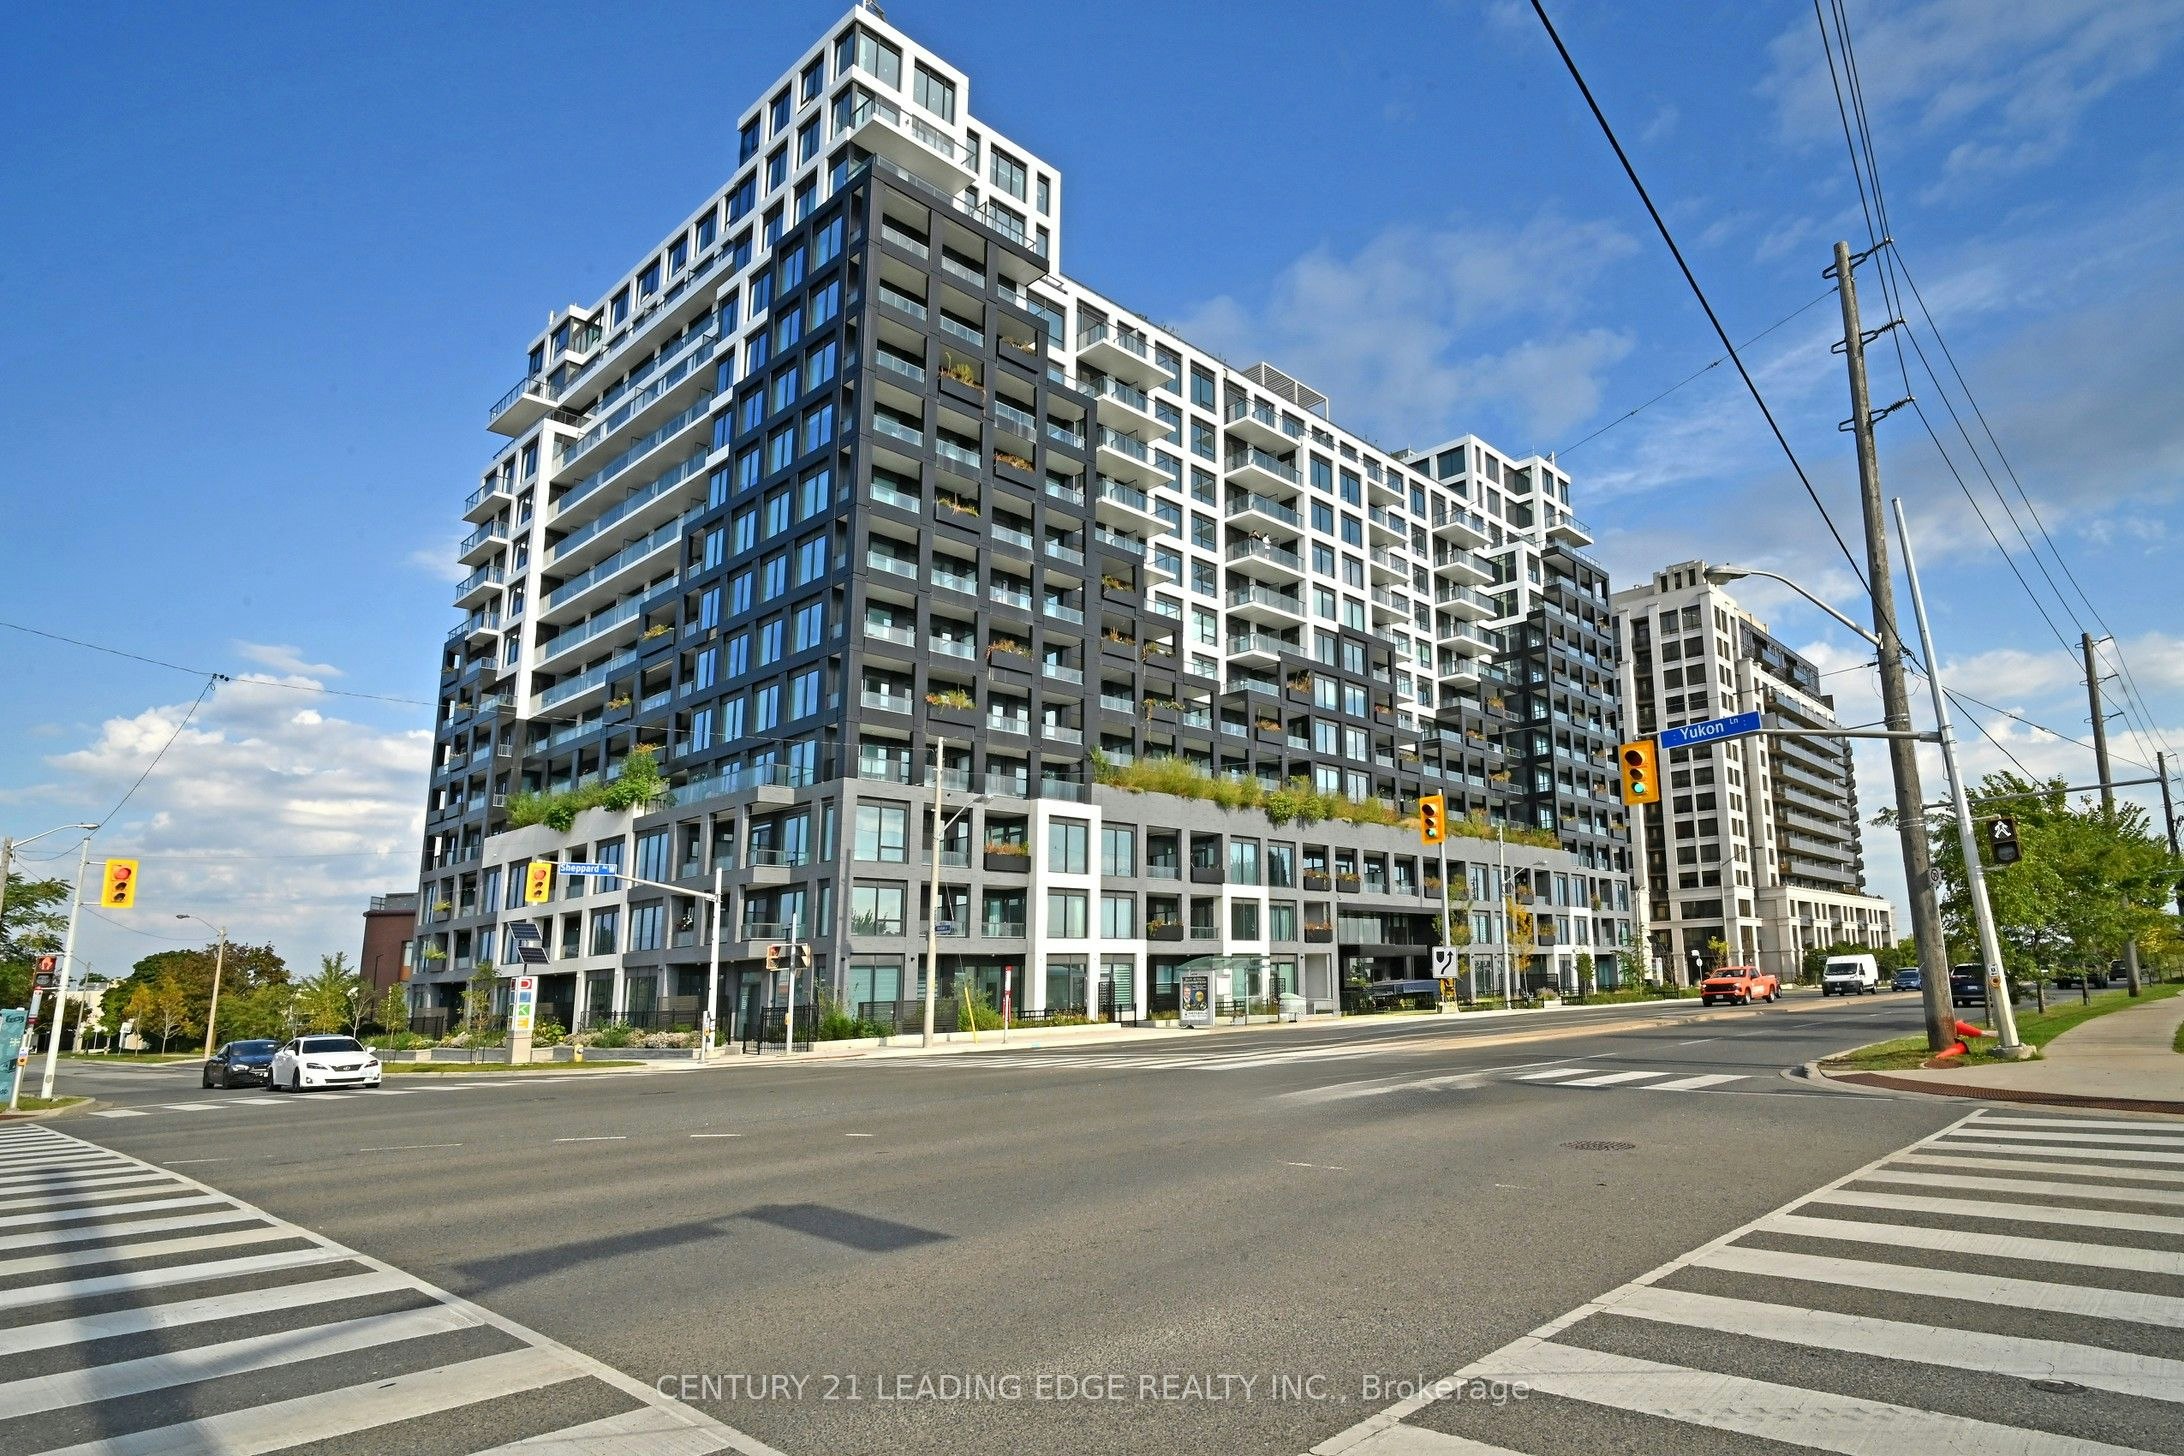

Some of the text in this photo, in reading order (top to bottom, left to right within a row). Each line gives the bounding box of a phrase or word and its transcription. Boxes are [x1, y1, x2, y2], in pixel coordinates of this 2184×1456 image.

[1680, 717, 1739, 740] Yukon Ln
[560, 863, 599, 874] Sheppard
